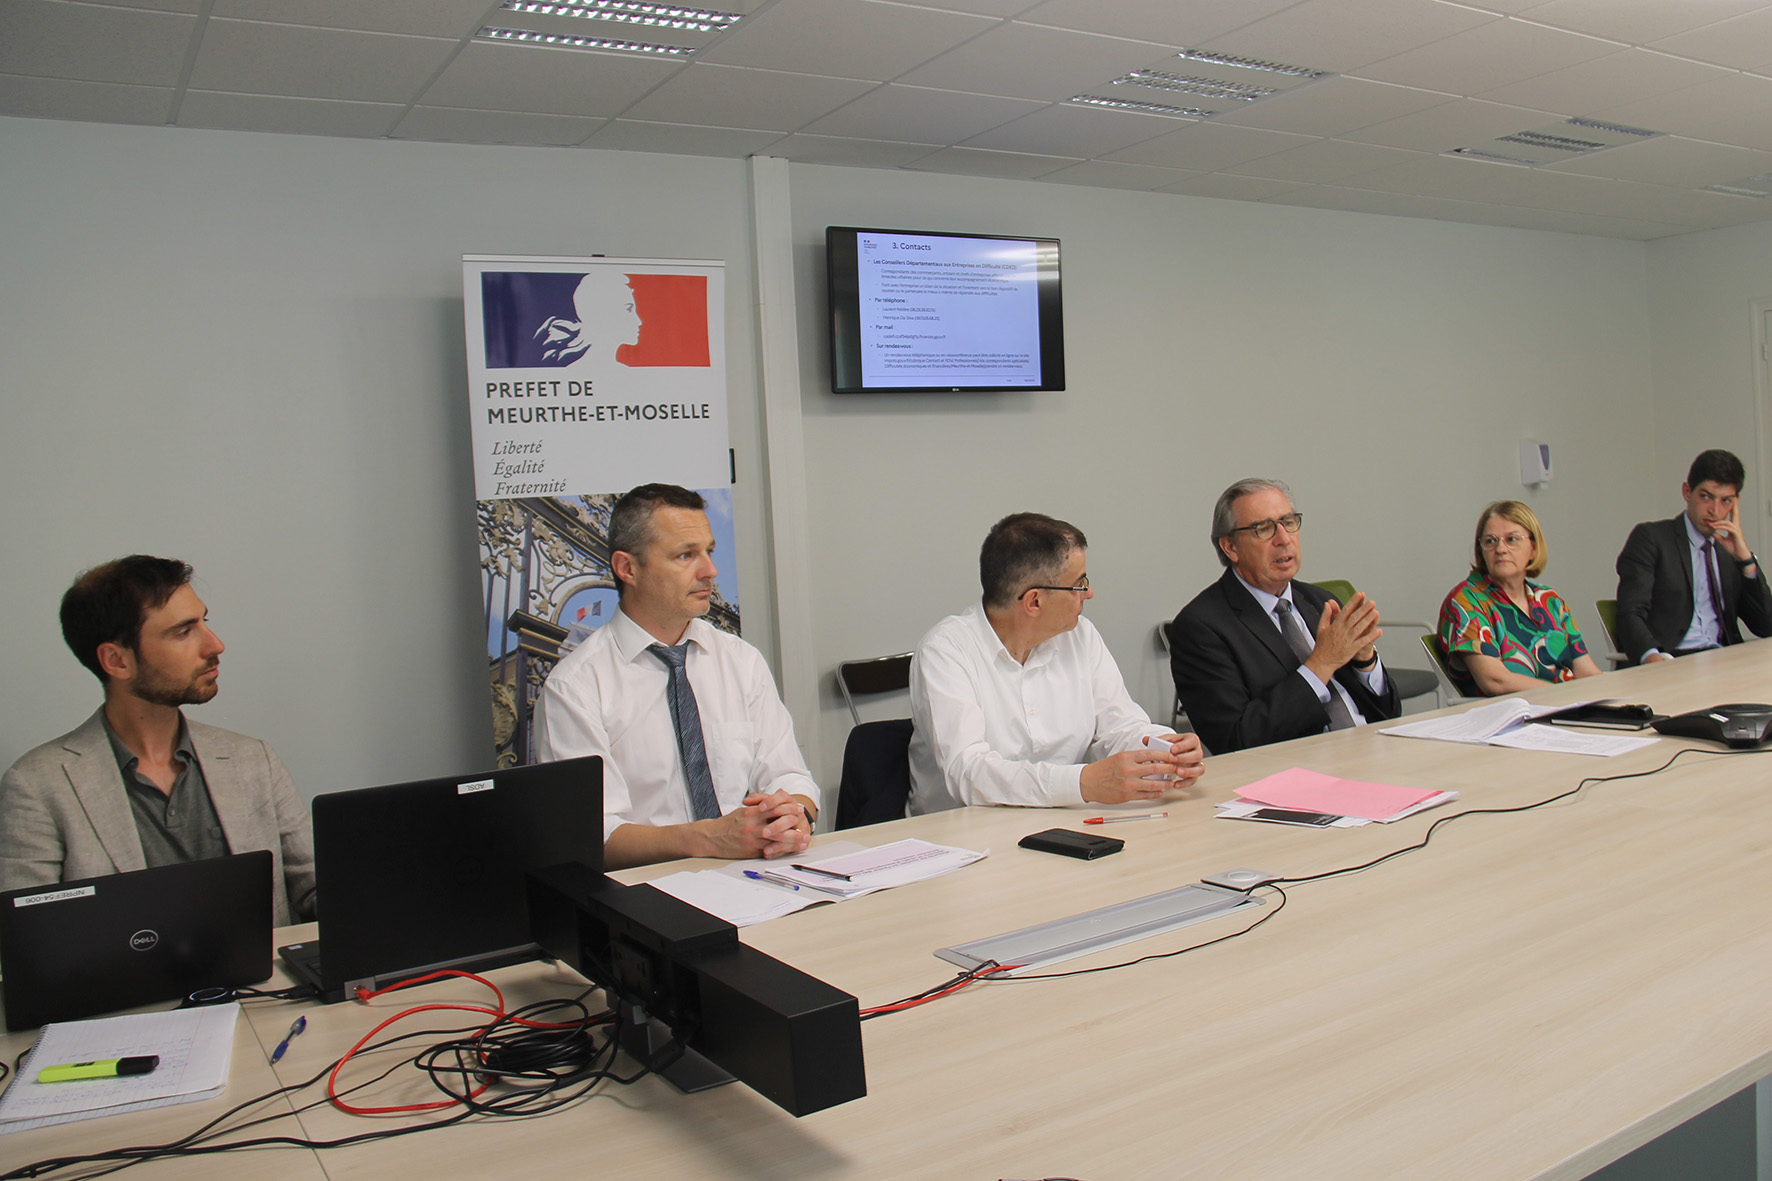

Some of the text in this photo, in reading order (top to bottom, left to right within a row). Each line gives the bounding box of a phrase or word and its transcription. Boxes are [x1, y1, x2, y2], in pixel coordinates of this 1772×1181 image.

[486, 380, 594, 398] PREFET DE
[488, 403, 710, 424] MEURTHE-ET-MOSELLE
[492, 440, 542, 456] Liberté
[492, 460, 545, 478] Égalité
[494, 478, 567, 496] Fraternité
[466, 783, 485, 791] ADSL
[133, 936, 155, 945] DELL
